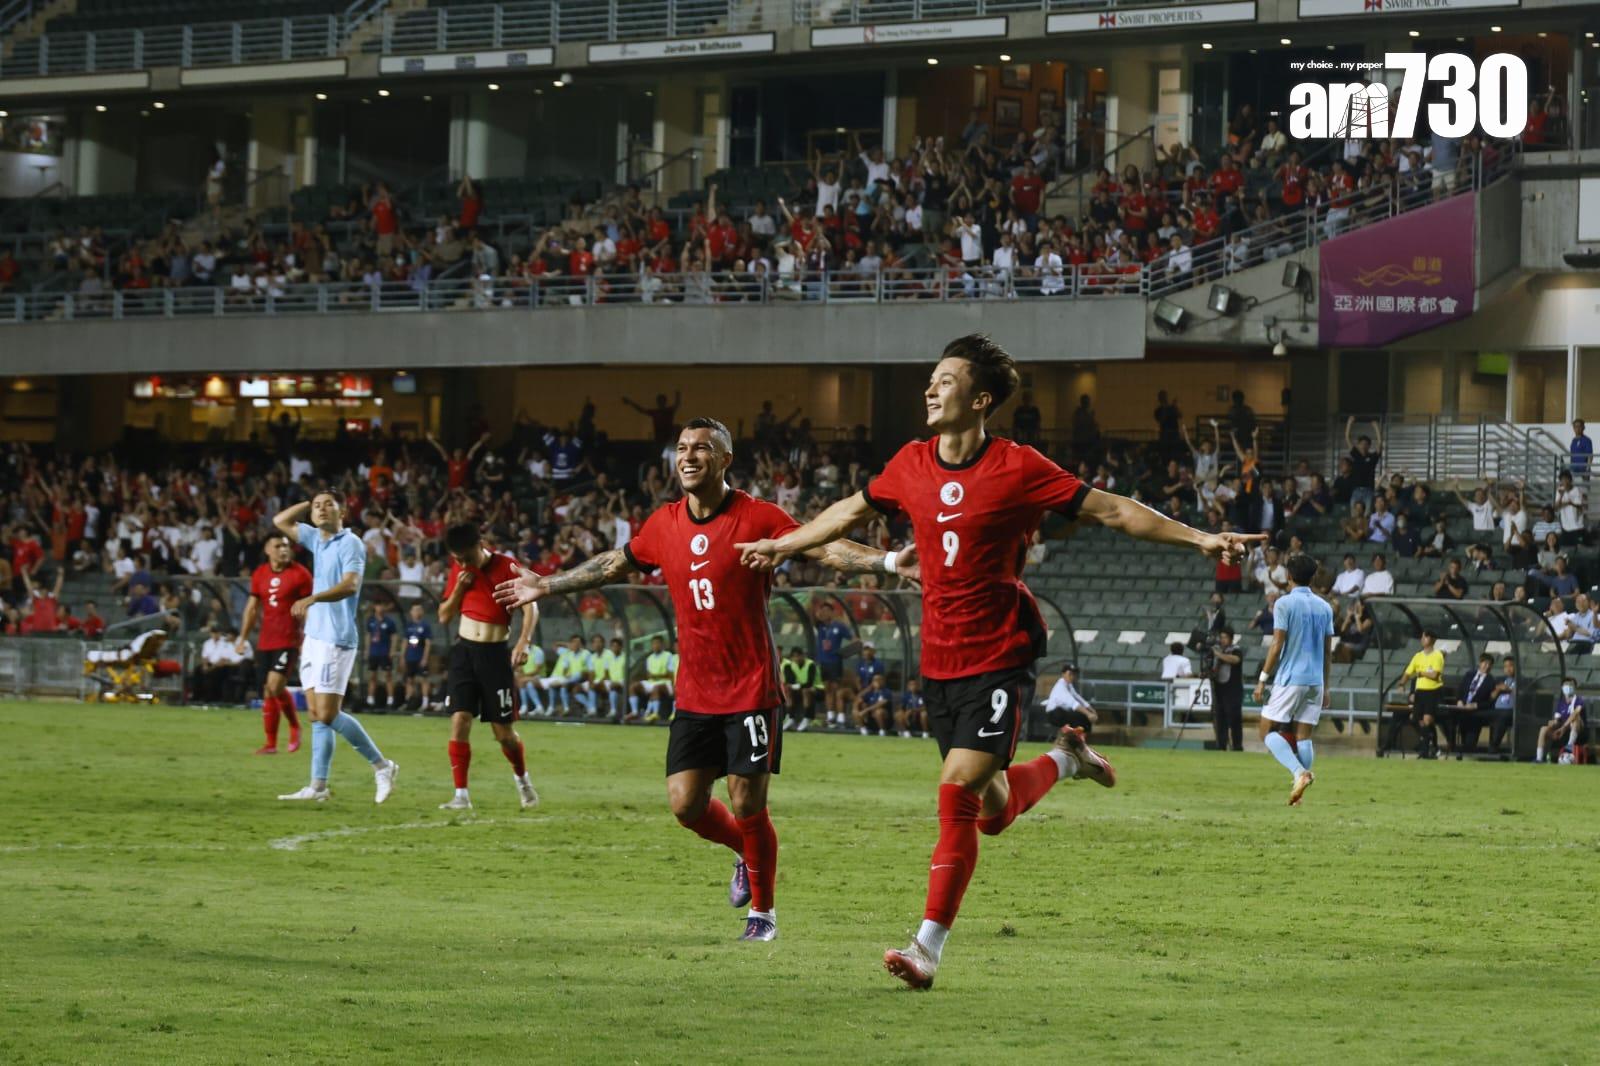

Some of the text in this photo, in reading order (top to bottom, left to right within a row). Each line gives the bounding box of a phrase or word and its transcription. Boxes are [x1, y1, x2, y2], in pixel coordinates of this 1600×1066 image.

[1148, 9, 1203, 23] PROPERTIES
[1333, 294, 1458, 314] 亞洲國際都會
[942, 530, 960, 567] 9
[688, 577, 716, 611] 13
[496, 688, 513, 708] 14
[990, 688, 1009, 725] 9
[1193, 688, 1210, 705] 26
[743, 714, 769, 747] 13
